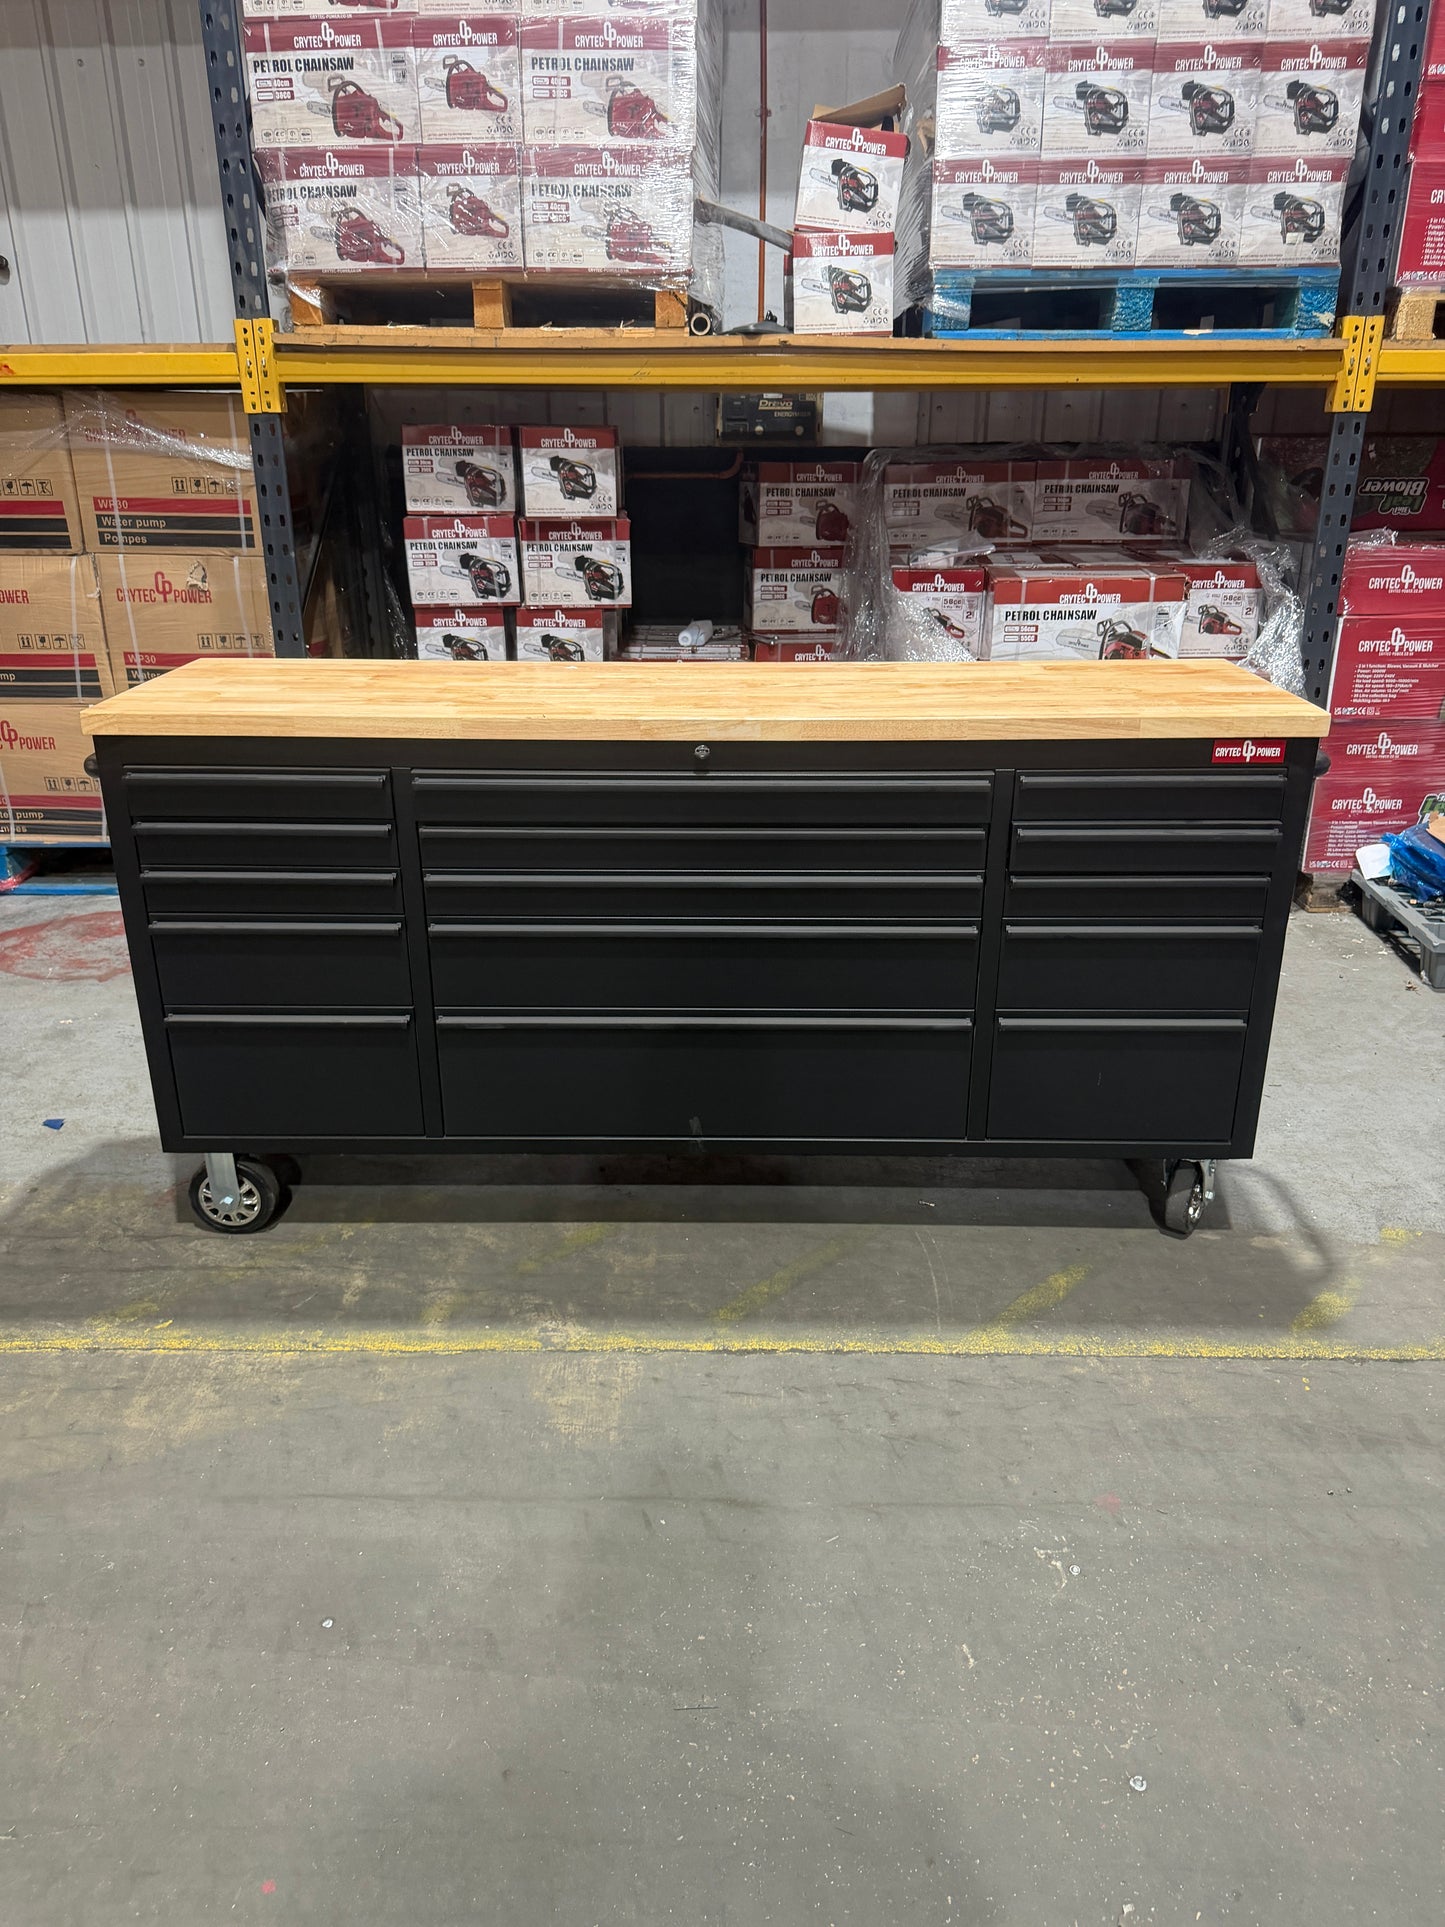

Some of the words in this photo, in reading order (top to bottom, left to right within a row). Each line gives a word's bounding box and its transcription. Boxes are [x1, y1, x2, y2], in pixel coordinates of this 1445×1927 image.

[294, 36, 322, 48] CRYTEC
[335, 35, 361, 47] POWER
[433, 34, 460, 46] CRYTEC
[472, 32, 497, 44] POWER
[575, 36, 604, 48] CRYTEC
[616, 35, 643, 48] POWER
[295, 57, 354, 71] CHAINSAW
[575, 58, 634, 71] CHAINSAW
[1000, 57, 1024, 68] POWER
[1068, 59, 1096, 72] CRYTEC
[1108, 58, 1133, 69] POWER
[1175, 59, 1203, 70] CRYTEC
[1216, 56, 1242, 69] POWER
[1281, 59, 1309, 70] CRYTEC
[1321, 57, 1347, 68] POWER
[826, 136, 851, 150] CRYTEC
[862, 142, 886, 155] POWER
[300, 164, 327, 177] CRYTEC
[339, 164, 364, 176] POWER
[436, 163, 464, 174] CRYTEC
[475, 162, 500, 173] POWER
[574, 164, 602, 175] CRYTEC
[955, 172, 982, 183] CRYTEC
[993, 172, 1018, 183] POWER
[1060, 172, 1086, 183] CRYTEC
[1098, 172, 1123, 183] POWER
[1164, 173, 1192, 183] CRYTEC
[1203, 172, 1228, 183] POWER
[1268, 172, 1295, 182] CRYTEC
[1306, 170, 1332, 182] POWER
[813, 246, 839, 256] CRYTEC
[850, 245, 873, 255] POWER
[429, 436, 452, 445] CRYTEC
[462, 435, 483, 444] POWER
[541, 439, 565, 448] CRYTEC
[575, 439, 596, 448] POWER
[434, 448, 474, 456] CHAINSAW
[796, 488, 836, 496] CHAINSAW
[1075, 484, 1119, 494] CHAINSAW
[1362, 481, 1425, 495] Blower
[136, 520, 166, 528] pump
[432, 529, 455, 538] CRYTEC
[465, 529, 487, 537] POWER
[549, 531, 572, 540] CRYTEC
[581, 531, 602, 540] POWER
[438, 541, 478, 549] CHAINSAW
[554, 543, 592, 552] CHAINSAW
[790, 573, 832, 582] CHAINSAW
[912, 583, 934, 591] CRYTEC
[944, 583, 964, 591] POWER
[1192, 580, 1214, 588] CRYTEC
[1224, 580, 1245, 588] POWER
[1369, 577, 1400, 590] CRYTEC
[1414, 577, 1443, 589] POWER
[174, 589, 213, 604] POWER
[1059, 594, 1085, 604] CRYTEC
[1097, 593, 1121, 603] POWER
[1005, 610, 1040, 621] PETROL
[1043, 610, 1097, 620] CHAINSAW
[433, 617, 456, 626] CRYTEC
[465, 617, 487, 626] POWER
[533, 618, 556, 627] CRYTEC
[565, 618, 586, 627] POWER
[1358, 640, 1391, 652] CRYTEC
[1404, 640, 1433, 652] POWER
[795, 652, 815, 661] CRYTEC
[20, 737, 56, 750] POWER
[1215, 747, 1241, 757] CRYTEC
[1256, 747, 1280, 757] POWER
[1347, 744, 1377, 755] CRYTEC
[1390, 744, 1418, 755] POWER
[1332, 800, 1362, 810] CRYTEC
[1374, 799, 1402, 810] POWER
[16, 810, 44, 821] pump
